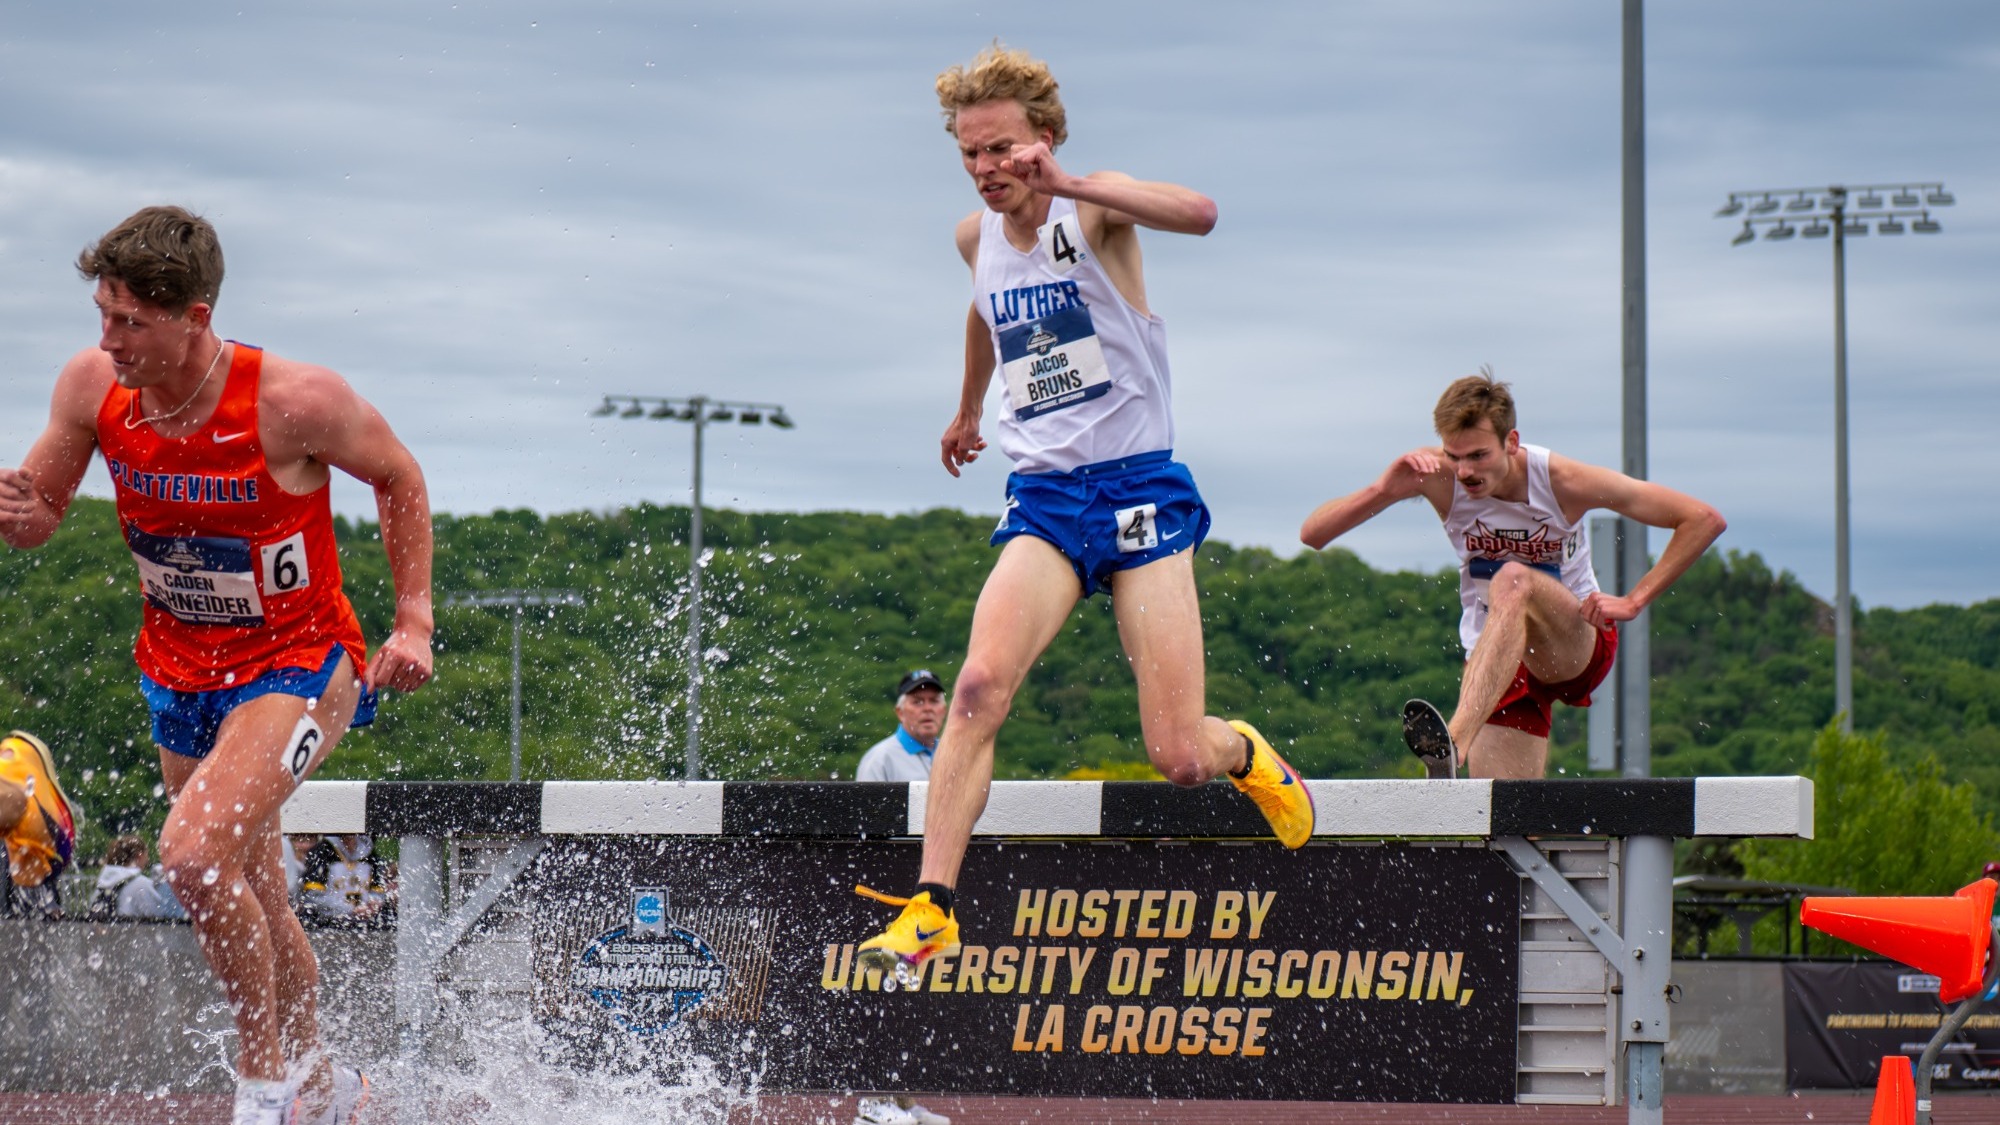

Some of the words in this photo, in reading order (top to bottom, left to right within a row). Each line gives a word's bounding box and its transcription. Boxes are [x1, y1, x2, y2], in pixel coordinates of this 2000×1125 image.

[1053, 222, 1077, 265] 4
[990, 280, 1083, 326] LUTHER
[1029, 352, 1069, 377] JACOB
[1027, 369, 1083, 402] BRUNS
[110, 459, 259, 503] PLATTEVILLE
[1123, 509, 1148, 547] 4
[1467, 535, 1561, 552] RAIDERS
[1499, 531, 1526, 540] MSOE
[162, 572, 216, 593] CADEN
[273, 543, 299, 591] 6
[147, 579, 252, 615] SCHNEIDER
[292, 728, 318, 777] 6
[638, 909, 663, 918] NCAA
[1013, 888, 1198, 939] HOSTED
[1209, 890, 1277, 940] BY
[575, 967, 724, 989] CHAMPIONSHIPS
[1107, 947, 1170, 996] OF
[1183, 949, 1474, 1006] WISCONSIN,
[1012, 1003, 1064, 1052] LA
[1081, 1005, 1272, 1056] CROSSE
